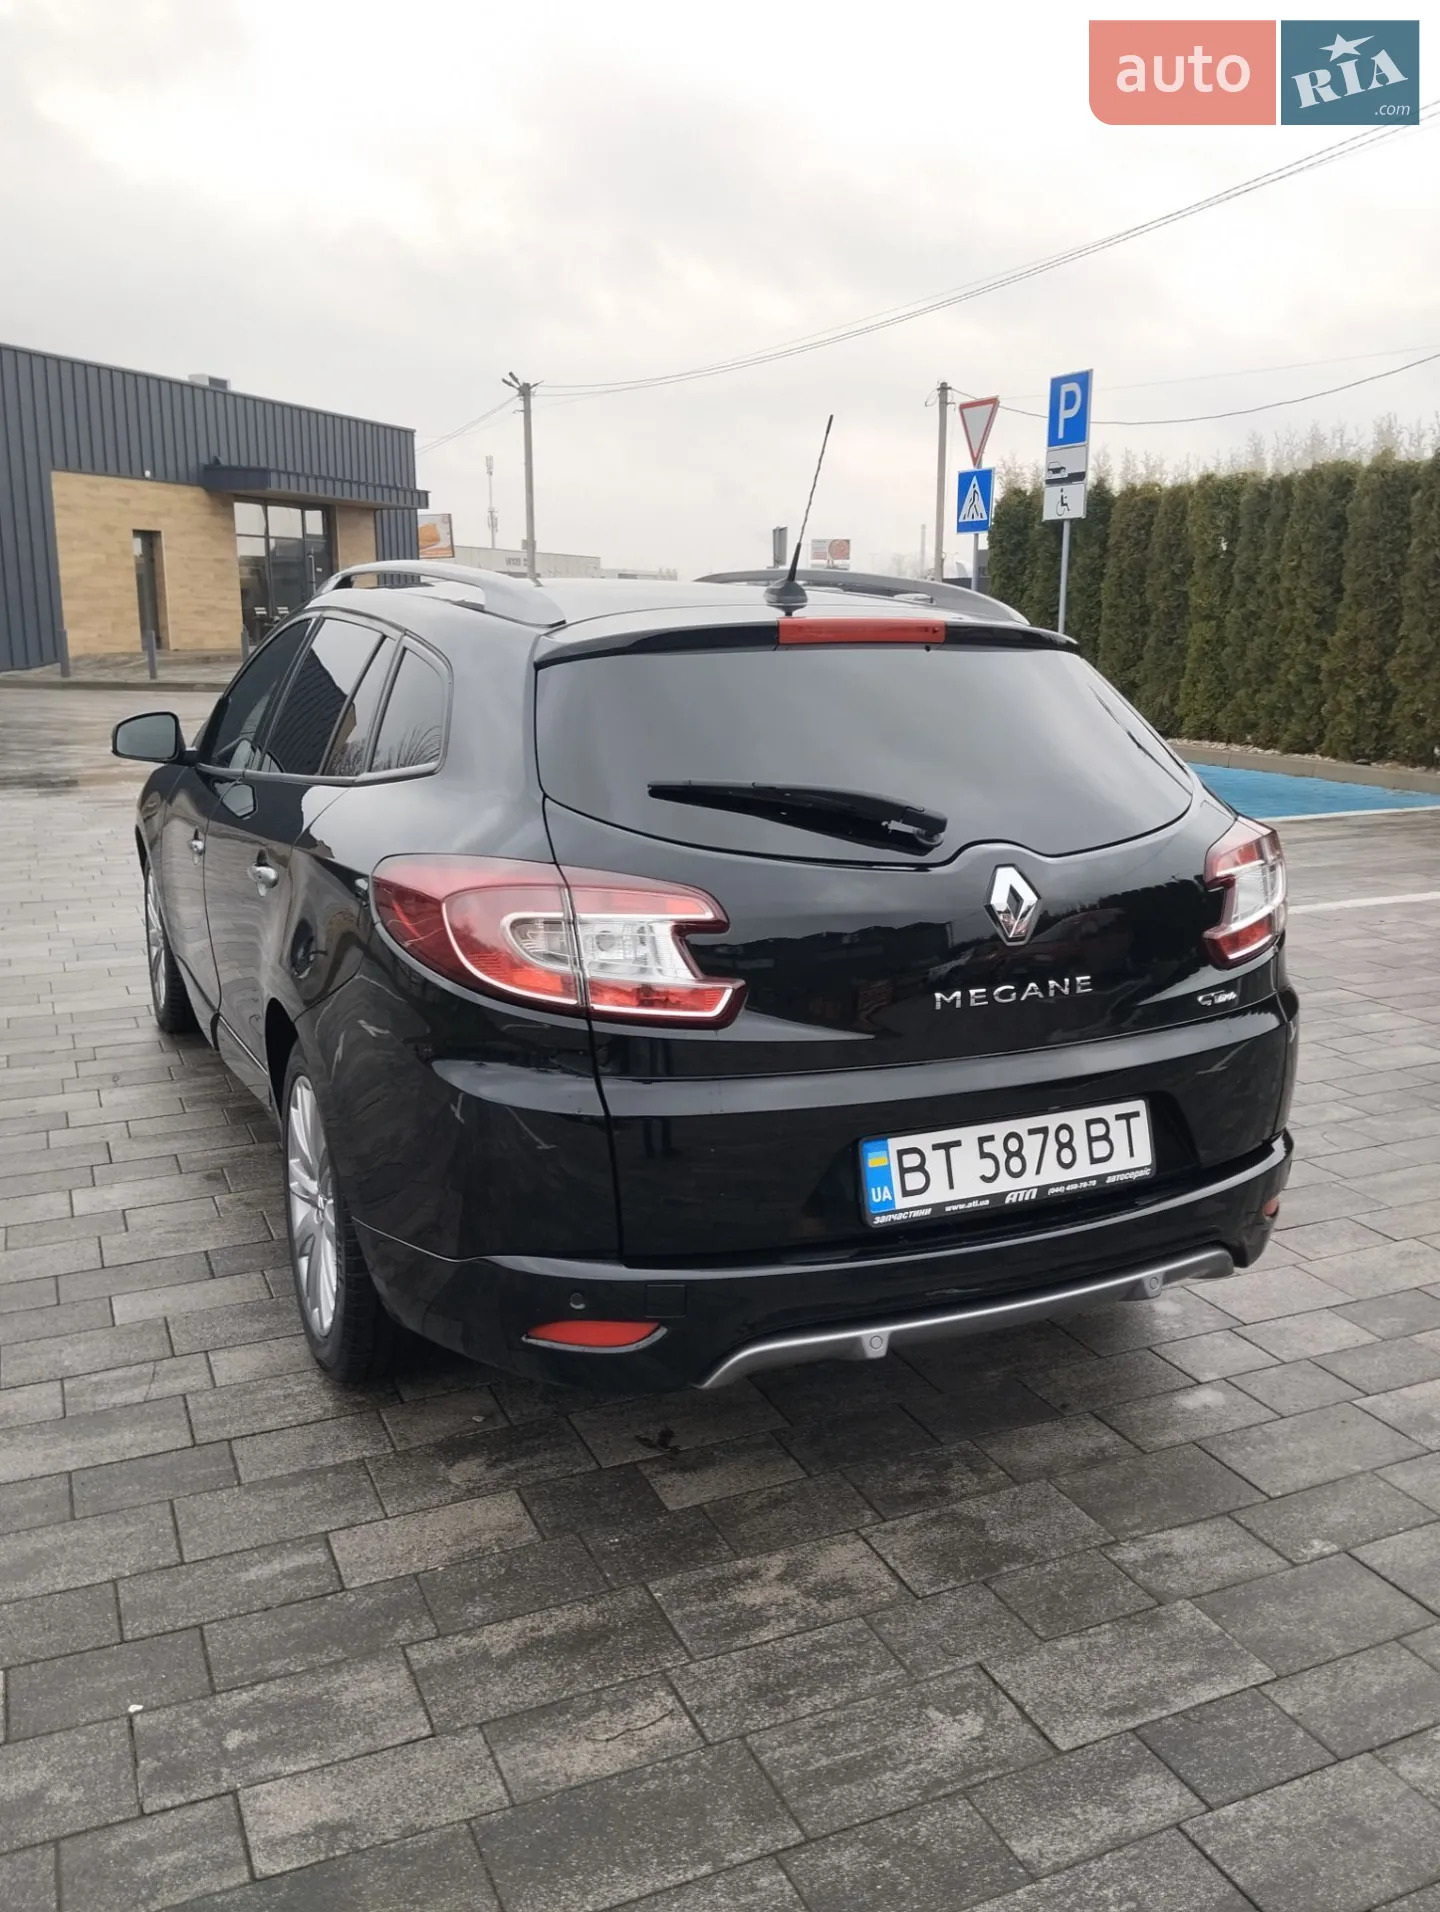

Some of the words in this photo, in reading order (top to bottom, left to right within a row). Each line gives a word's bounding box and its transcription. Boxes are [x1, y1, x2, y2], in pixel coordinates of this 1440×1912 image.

[1057, 382, 1082, 439] P
[933, 975, 1094, 1011] MEGANE
[896, 1140, 962, 1198] BT
[977, 1123, 1077, 1183] 5878
[1085, 1111, 1141, 1165] BT
[871, 1187, 893, 1203] UA
